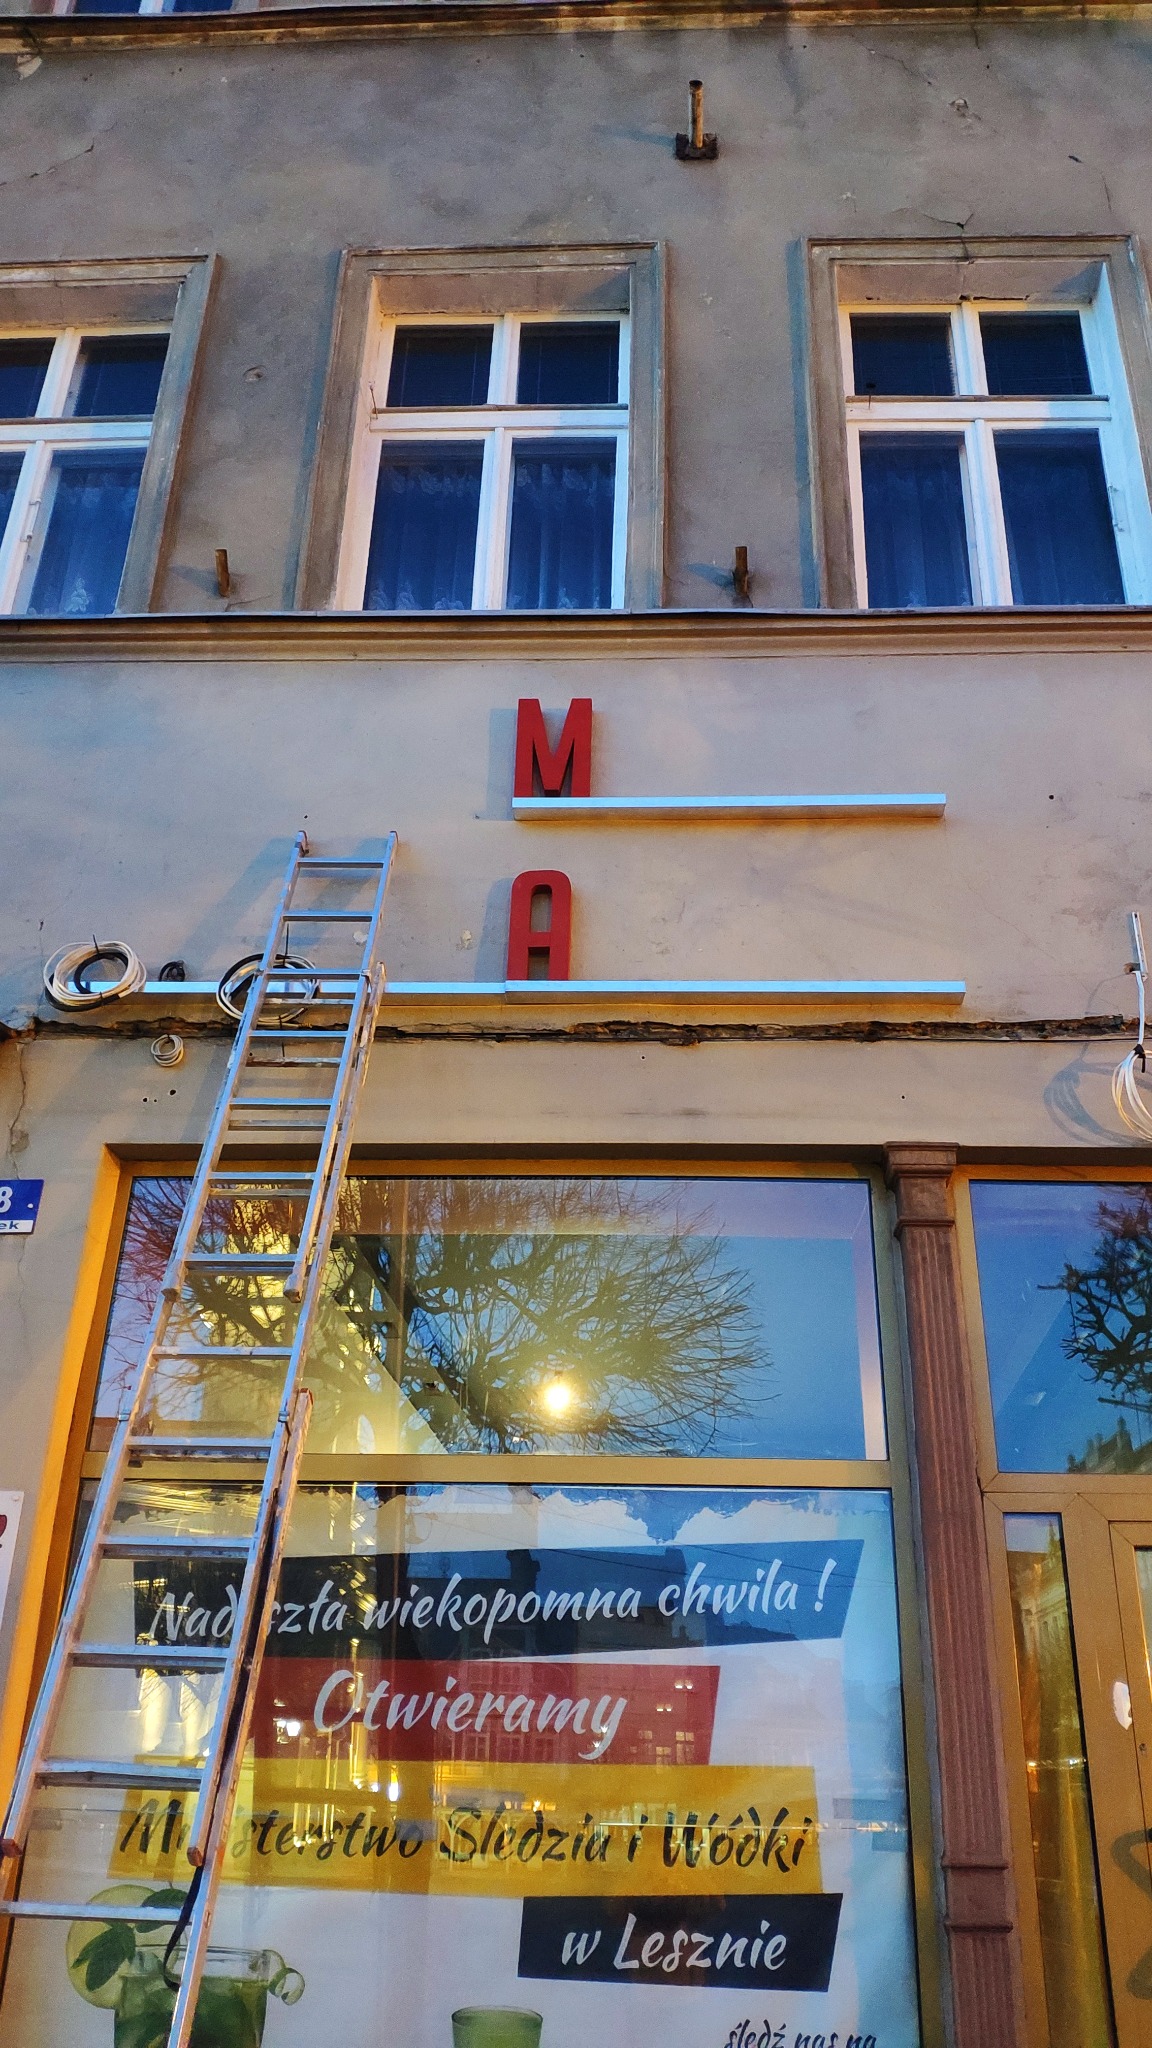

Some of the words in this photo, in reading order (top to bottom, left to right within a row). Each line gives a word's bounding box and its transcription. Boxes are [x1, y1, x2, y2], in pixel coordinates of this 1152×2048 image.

[513, 697, 592, 797] M
[506, 869, 572, 981] A
[363, 1572, 643, 1646] wiekopomna
[658, 1558, 799, 1616] chwila
[313, 1669, 629, 1761] Otwieramy
[627, 1812, 649, 1863] i
[662, 1806, 813, 1874] Wódki
[560, 1929, 602, 1967] w
[612, 1912, 788, 1973] Lesznie
[723, 2018, 788, 2048] śledź
[794, 2031, 840, 2048] nas
